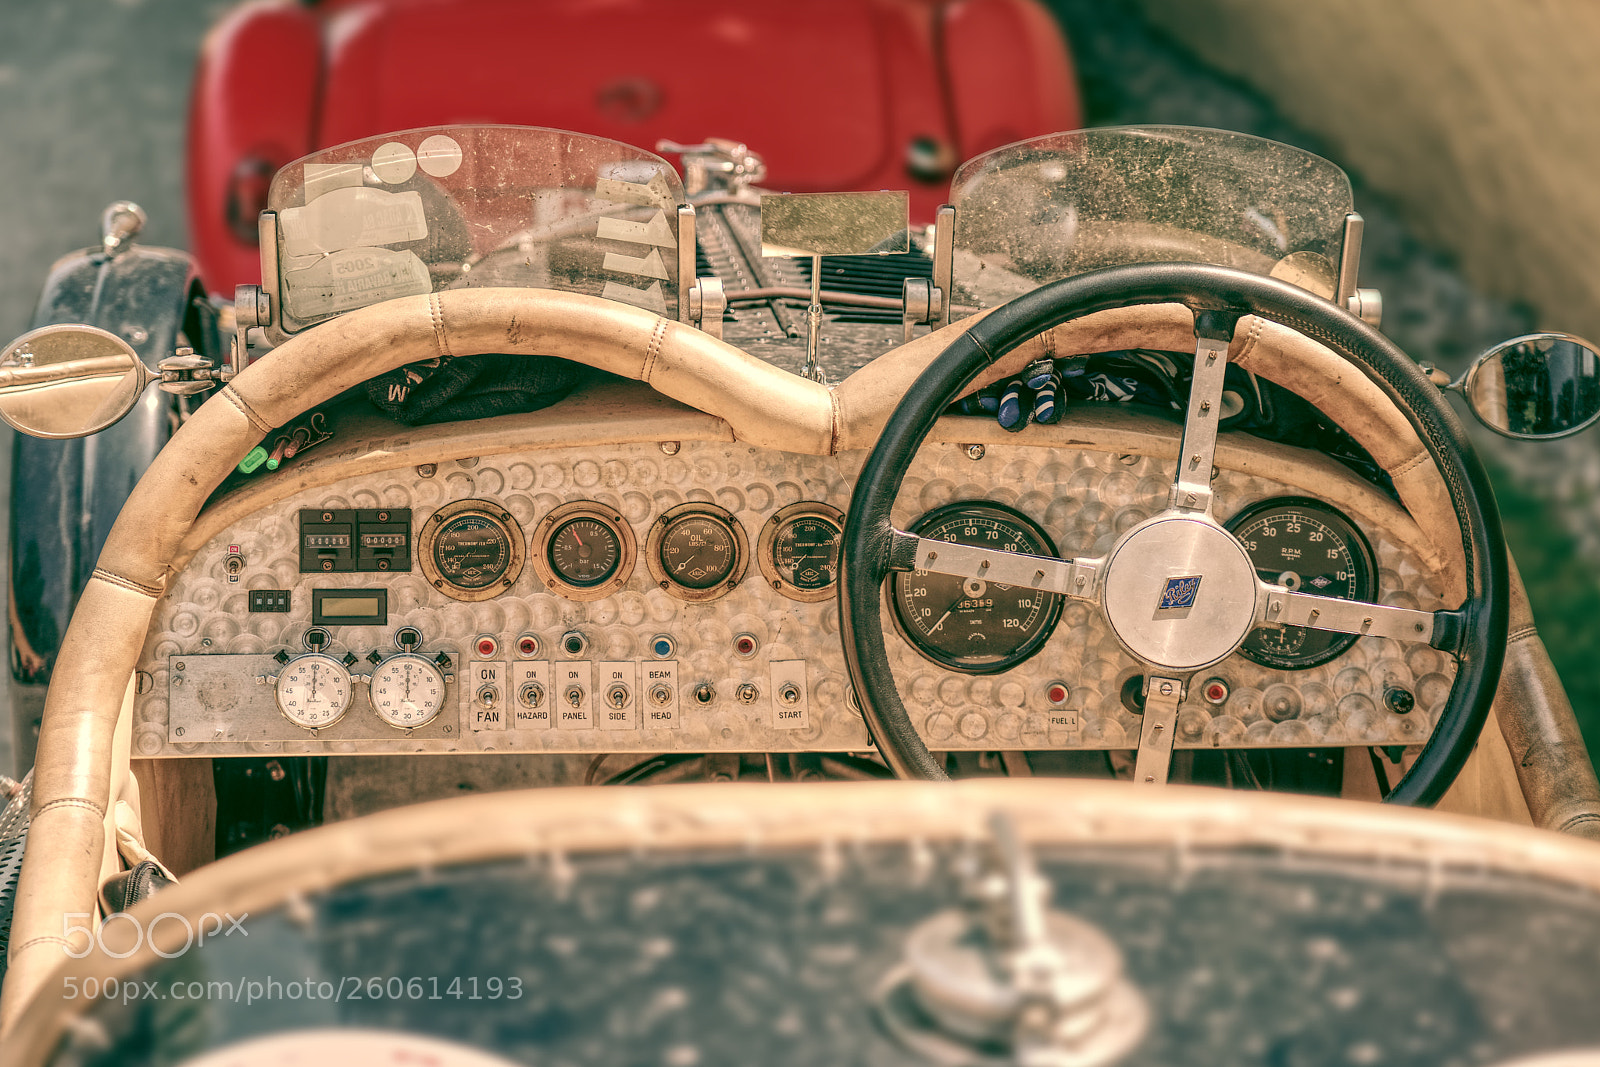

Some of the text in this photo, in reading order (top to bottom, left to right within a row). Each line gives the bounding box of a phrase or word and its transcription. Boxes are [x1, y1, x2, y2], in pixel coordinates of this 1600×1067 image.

[964, 527, 978, 536] 60
[1262, 528, 1277, 537] 30
[1286, 523, 1301, 533] 25
[944, 533, 957, 543] 50
[985, 531, 999, 540] 70
[1309, 532, 1324, 542] 20
[1004, 543, 1017, 552] 80
[1243, 541, 1257, 551] 35
[1327, 549, 1338, 559] 15
[1336, 571, 1347, 581] 10
[914, 588, 927, 597] 20
[1165, 579, 1197, 605] Riley
[1018, 599, 1032, 608] 110
[921, 608, 932, 617] 10
[1003, 618, 1020, 628] 120
[481, 669, 496, 680] ON
[526, 671, 537, 679] ON
[568, 671, 579, 679] ON
[612, 671, 623, 679] ON
[649, 671, 671, 679] BEAM
[477, 712, 499, 723] FAN
[517, 712, 548, 720] HAZARD
[651, 712, 672, 720] HEAD
[778, 711, 802, 719] START
